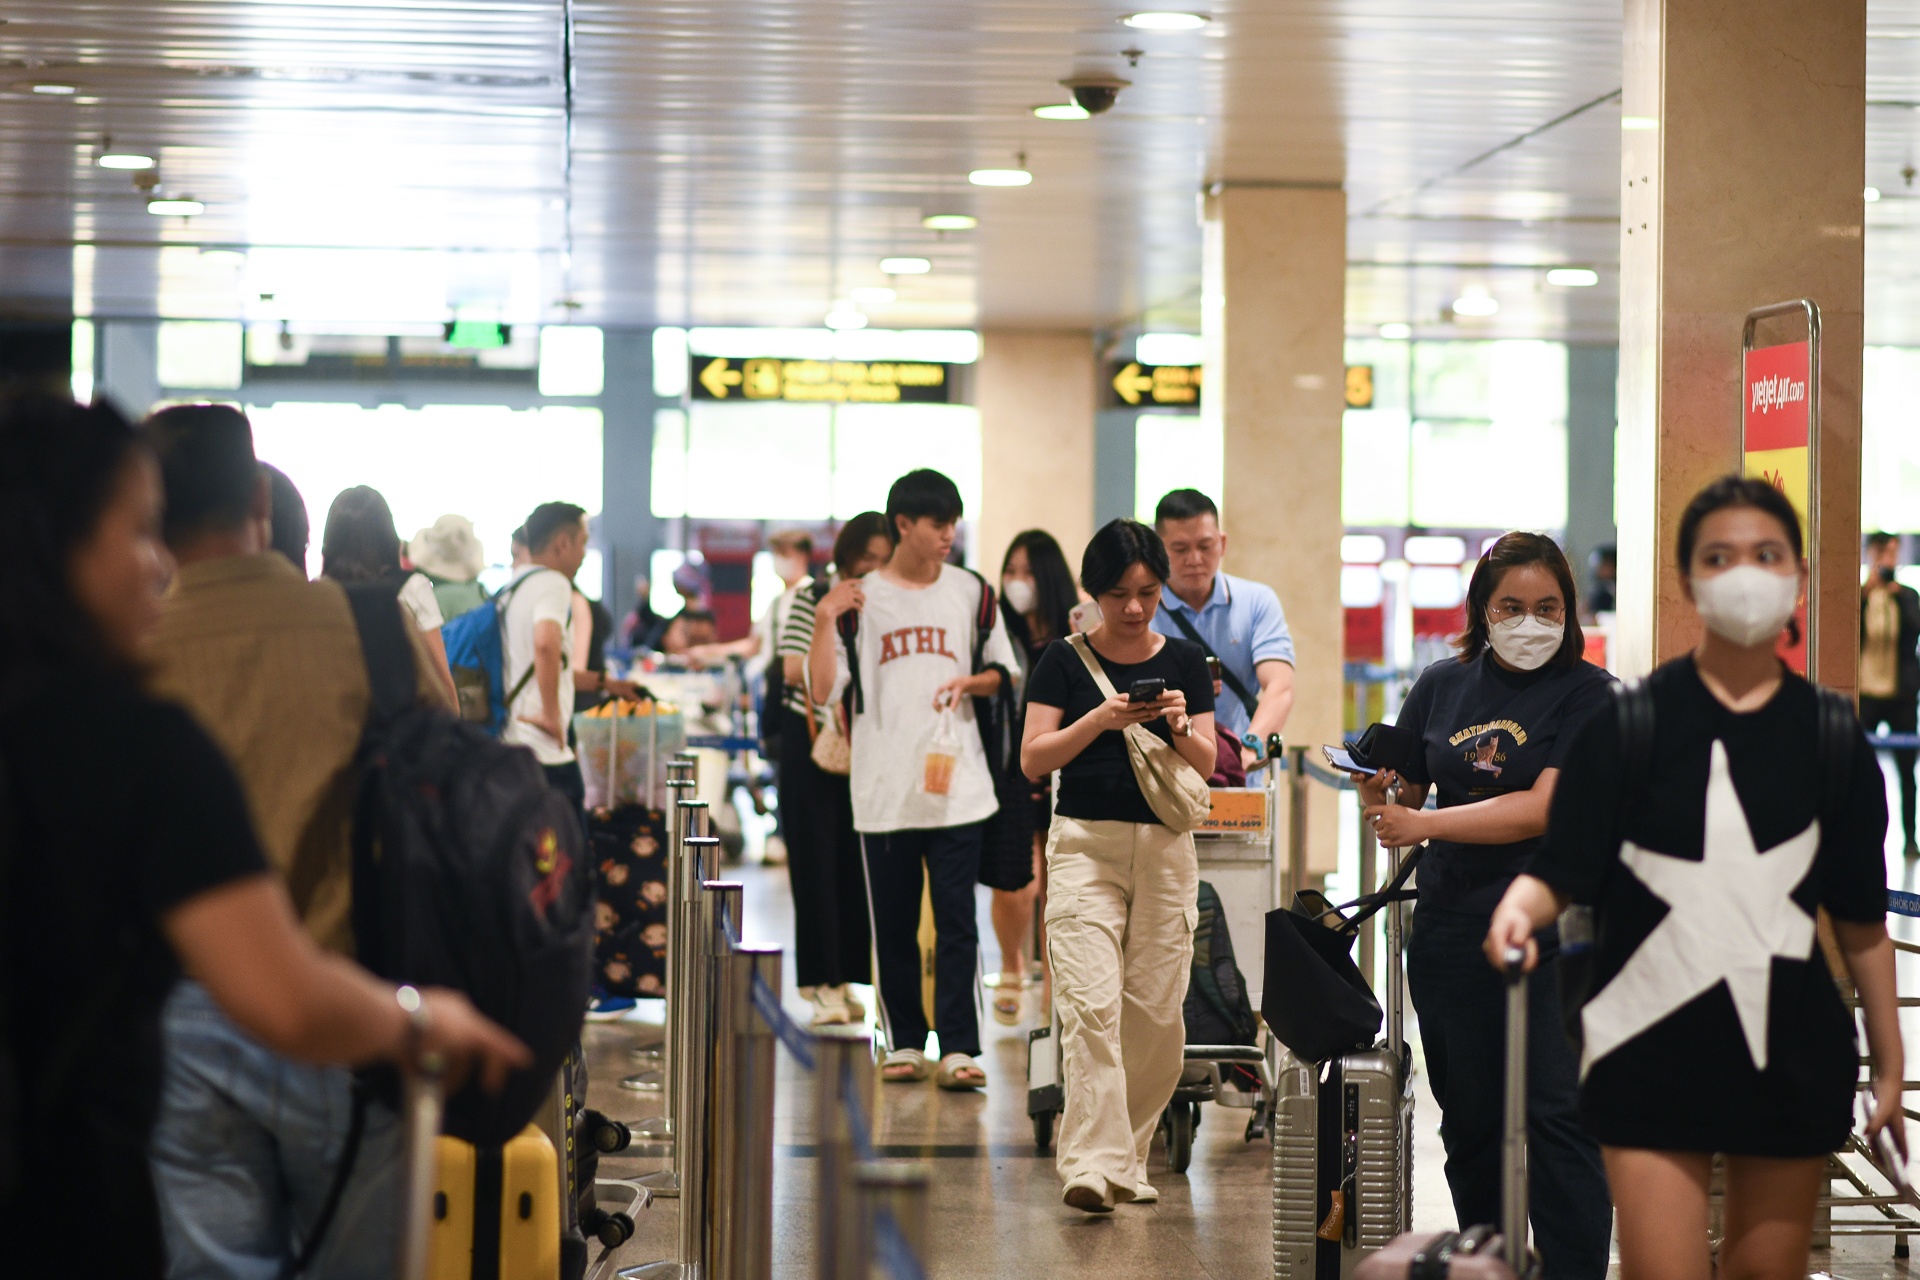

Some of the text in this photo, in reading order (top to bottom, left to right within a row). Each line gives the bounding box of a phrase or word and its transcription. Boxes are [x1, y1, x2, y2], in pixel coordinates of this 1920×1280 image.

[879, 626, 958, 665] ATHL
[1464, 751, 1506, 762] 19 86
[1240, 820, 1262, 828] 6699
